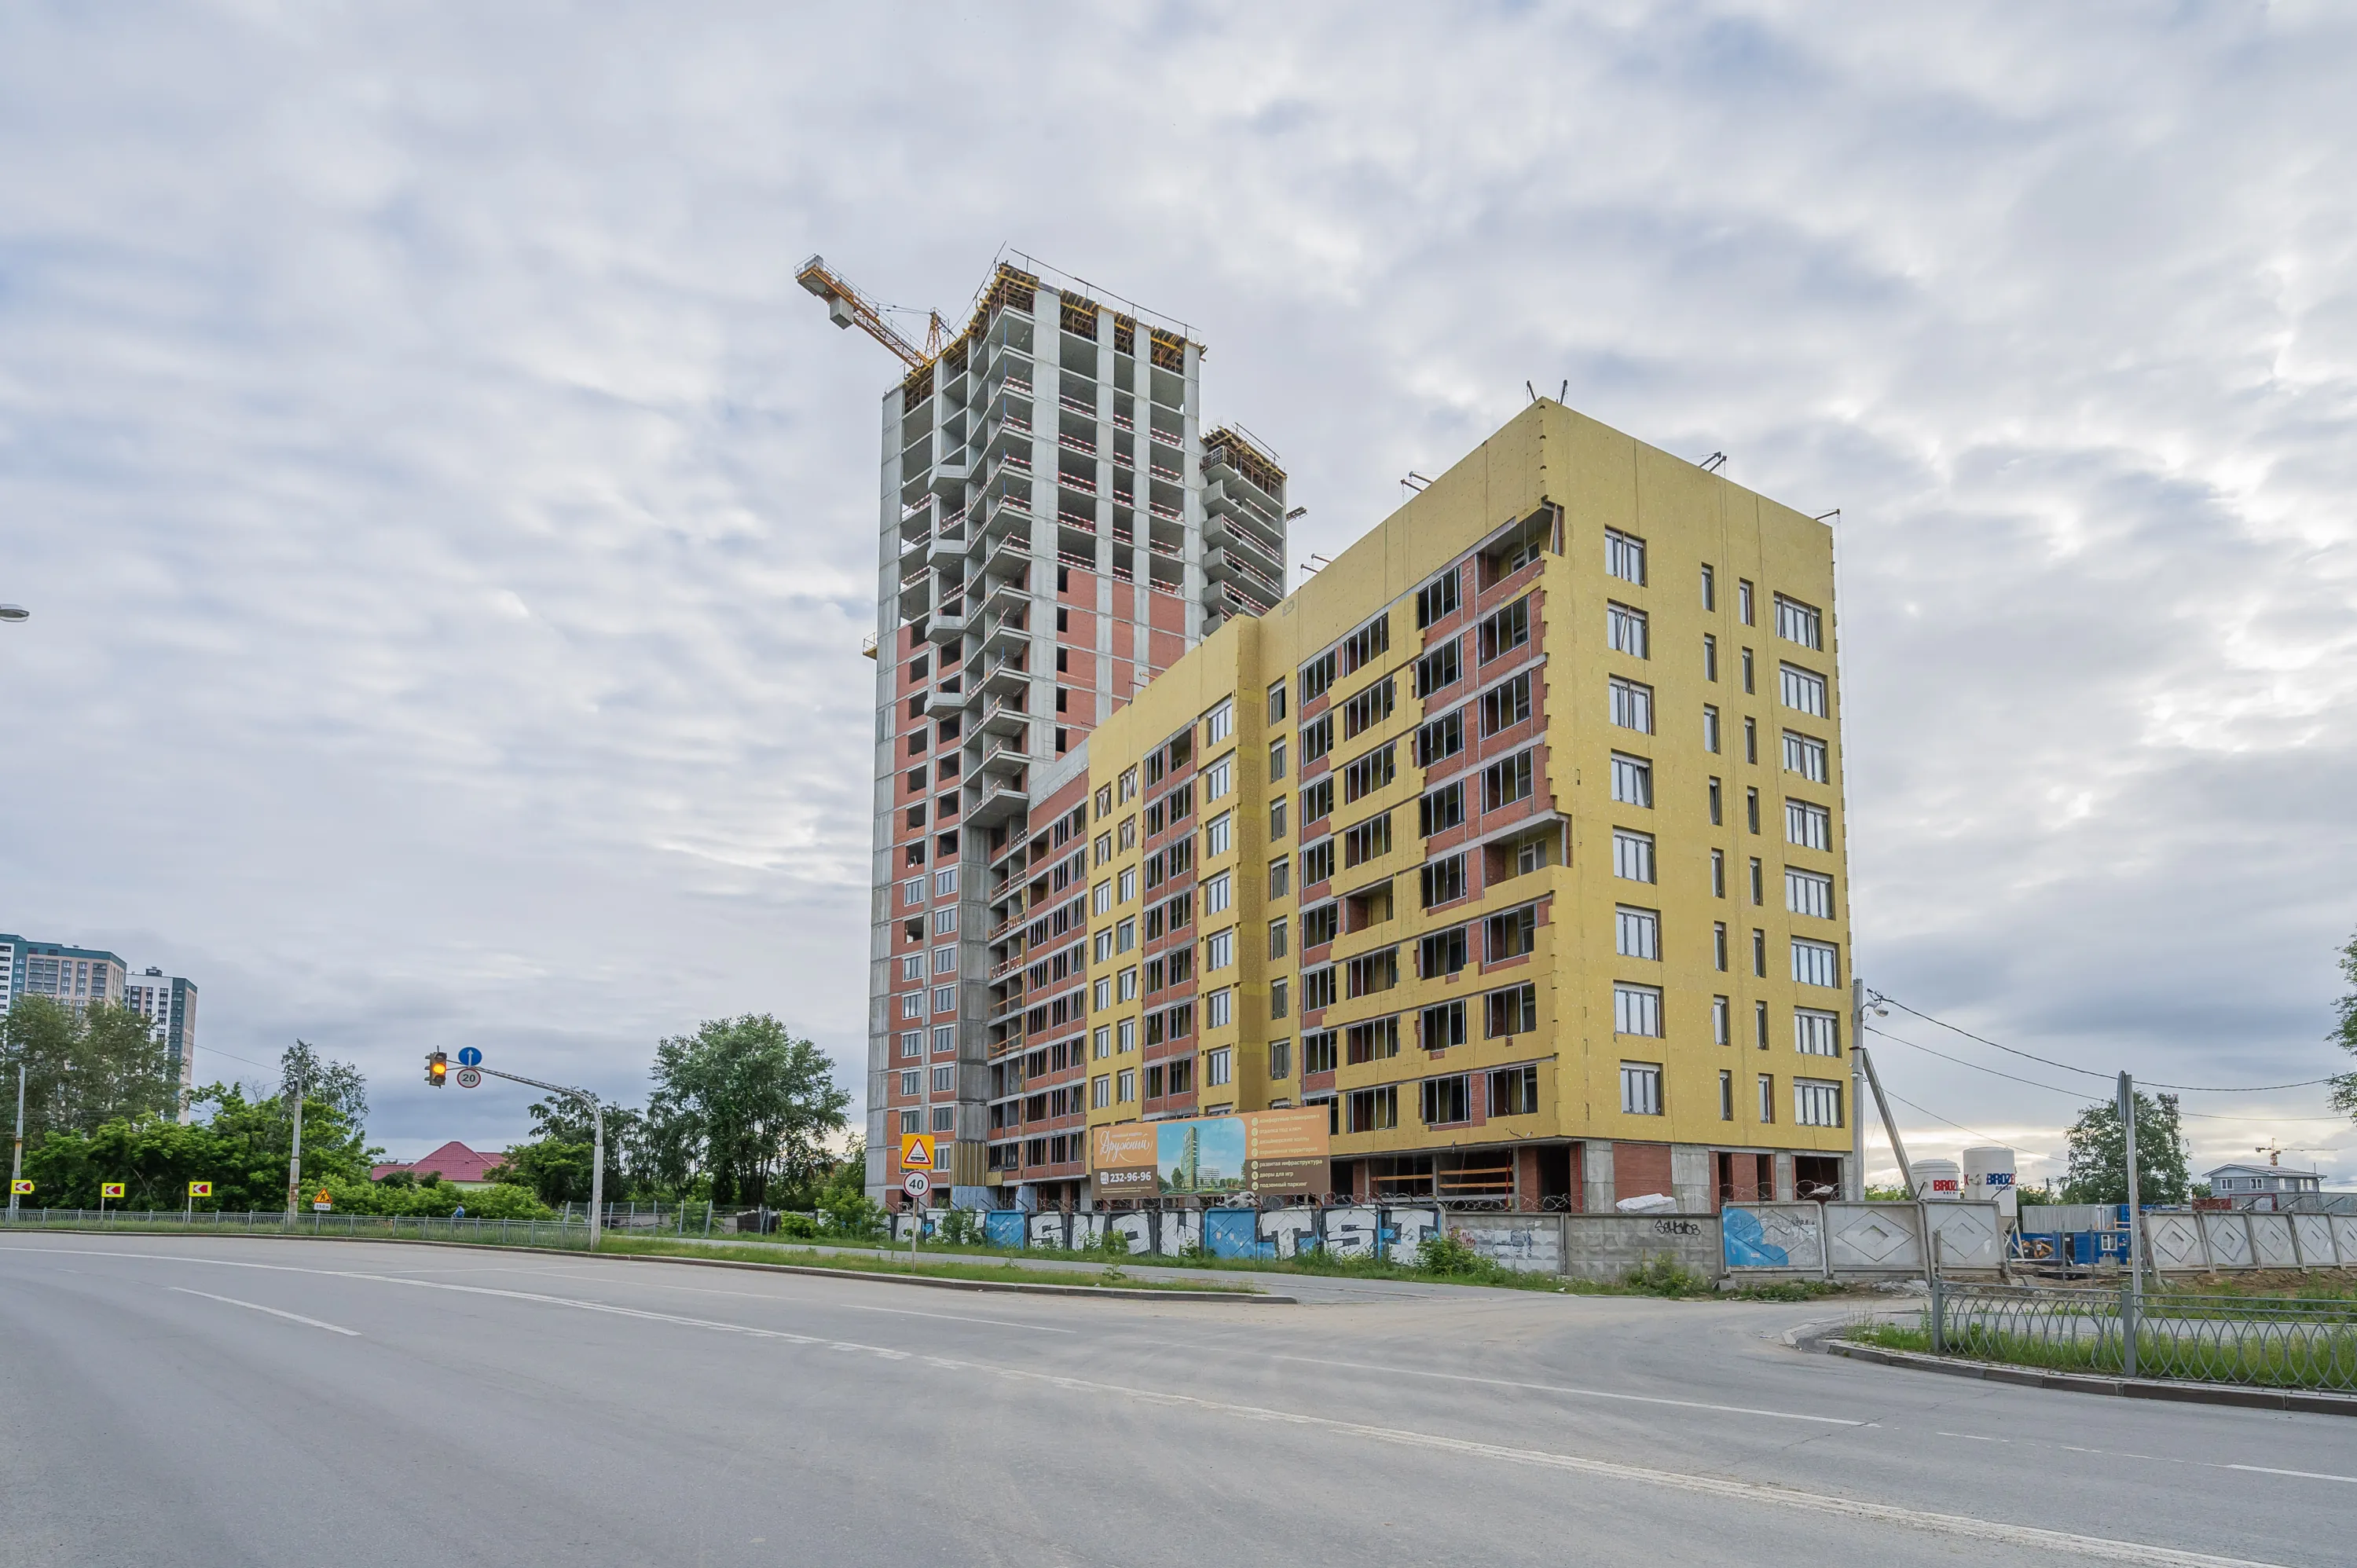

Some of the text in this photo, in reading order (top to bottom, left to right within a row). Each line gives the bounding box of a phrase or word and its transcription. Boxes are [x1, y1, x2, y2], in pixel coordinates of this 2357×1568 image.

[462, 1074, 476, 1083] 20
[1110, 1171, 1152, 1183] 232-96-96
[909, 1179, 924, 1190] 40
